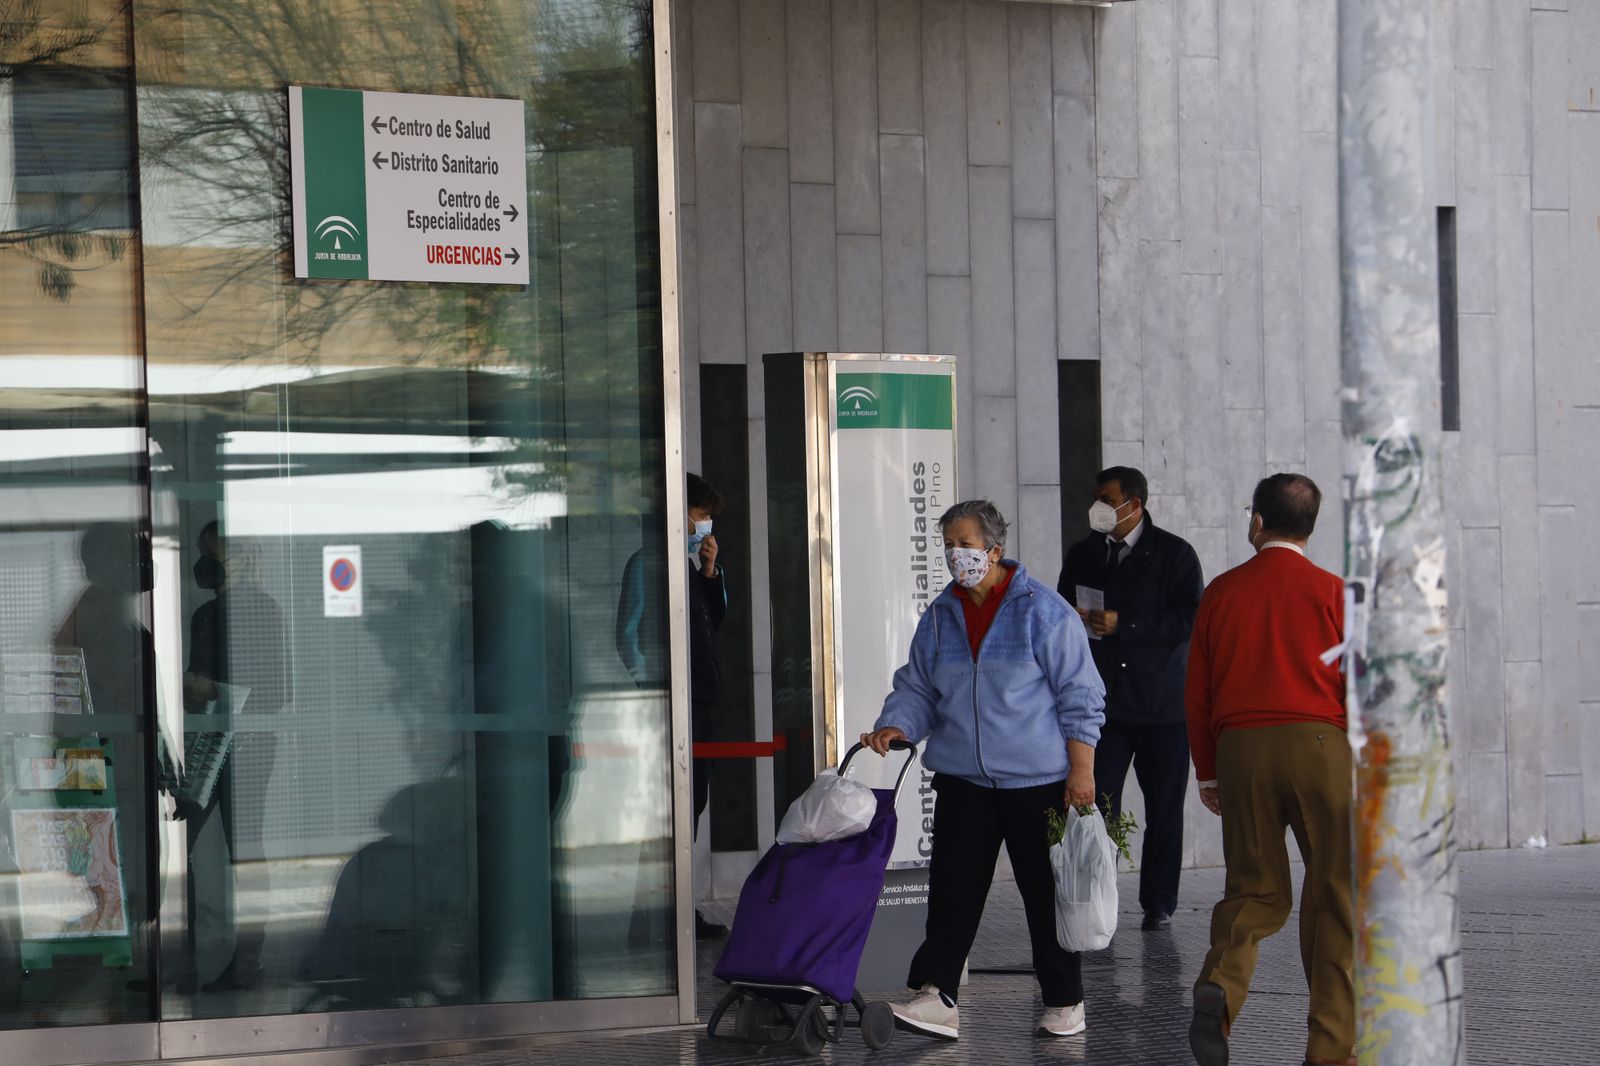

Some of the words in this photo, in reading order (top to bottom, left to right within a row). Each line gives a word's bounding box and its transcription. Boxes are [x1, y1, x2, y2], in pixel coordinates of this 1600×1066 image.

[389, 116, 433, 137] Centro
[436, 119, 452, 138] de
[455, 120, 491, 140] Salud
[391, 151, 438, 172] Distrito
[442, 154, 499, 175] Sanitario
[438, 188, 481, 208] Centro
[485, 190, 500, 209] de
[407, 209, 501, 233] Especialidades
[314, 252, 329, 260] JUNTA
[426, 244, 502, 265] URGENCIAS
[930, 462, 941, 507] Pino
[909, 461, 928, 618] cialidades
[931, 517, 942, 547] del
[932, 556, 944, 593] tilla
[918, 770, 934, 857] Centr
[879, 898, 885, 906] DE
[885, 897, 901, 905] SALUD
[904, 896, 928, 904] BIENESTAR
[883, 885, 902, 894] Servicio
[902, 884, 923, 892] Andaluz
